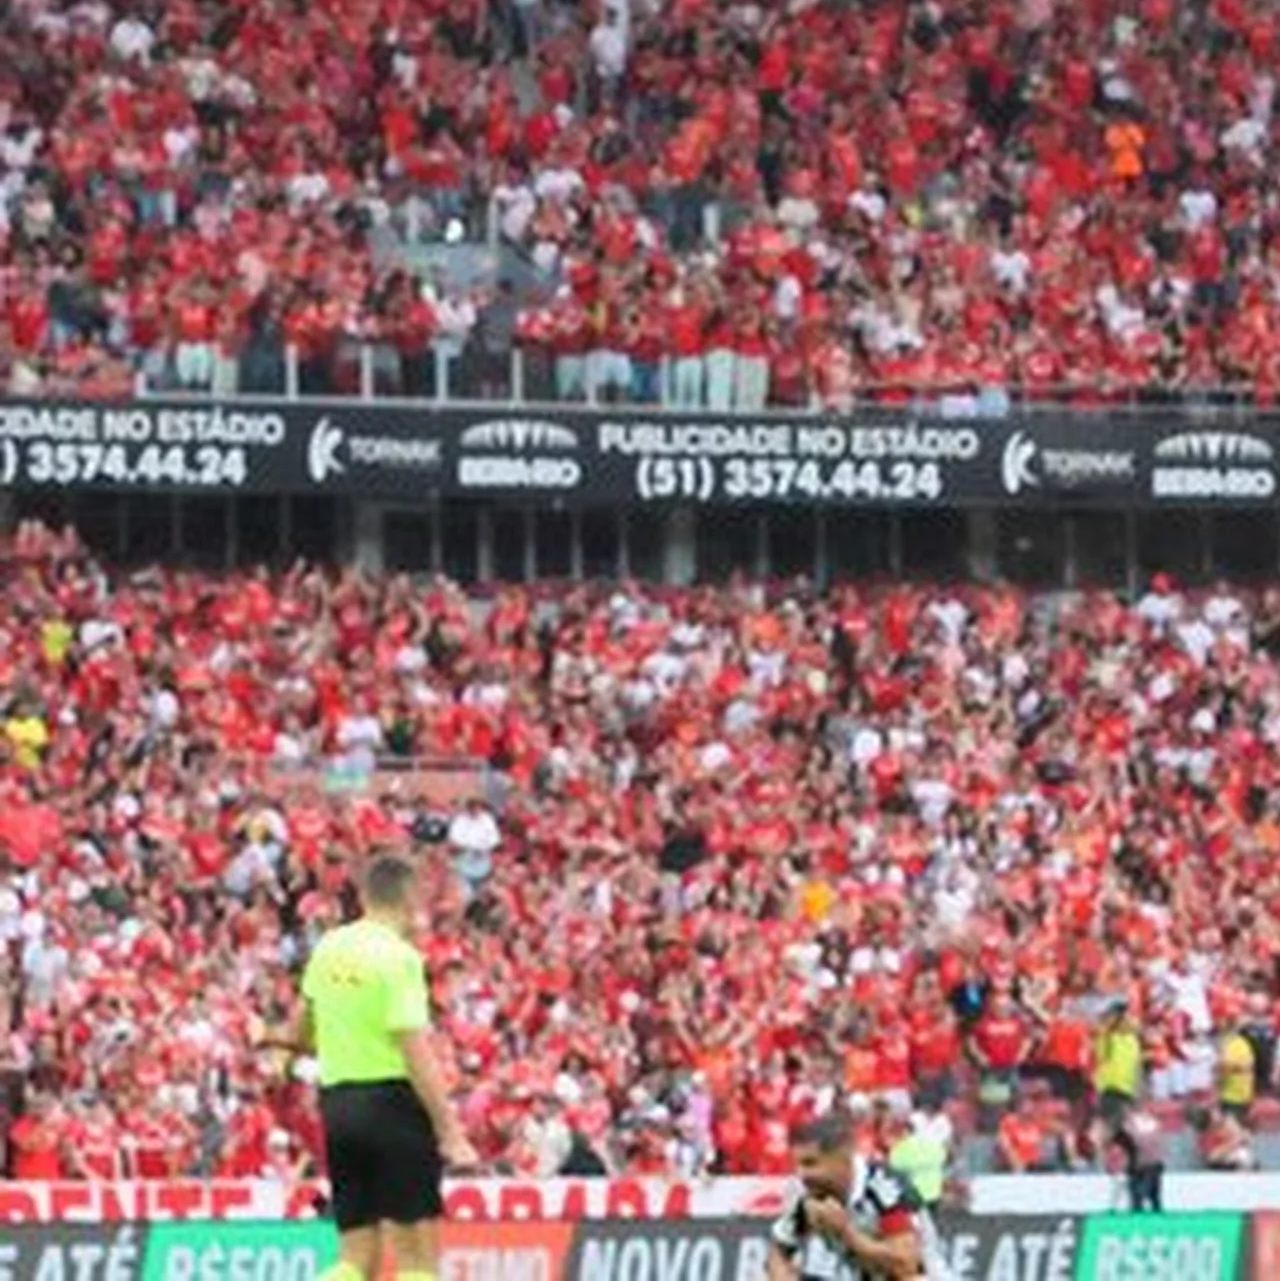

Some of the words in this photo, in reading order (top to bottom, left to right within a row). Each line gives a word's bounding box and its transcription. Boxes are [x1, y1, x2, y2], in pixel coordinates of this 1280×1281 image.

[103, 410, 151, 442] NO
[156, 405, 286, 445] ESTÁDIO
[599, 422, 790, 457] PUBLICIDADE
[797, 426, 846, 458] NO
[851, 419, 979, 459] ESTÁDIO
[26, 441, 248, 486] 3574.44.24
[636, 457, 714, 502] (51)
[723, 457, 943, 500] 3574.44.24
[576, 1235, 723, 1281] NOVO
